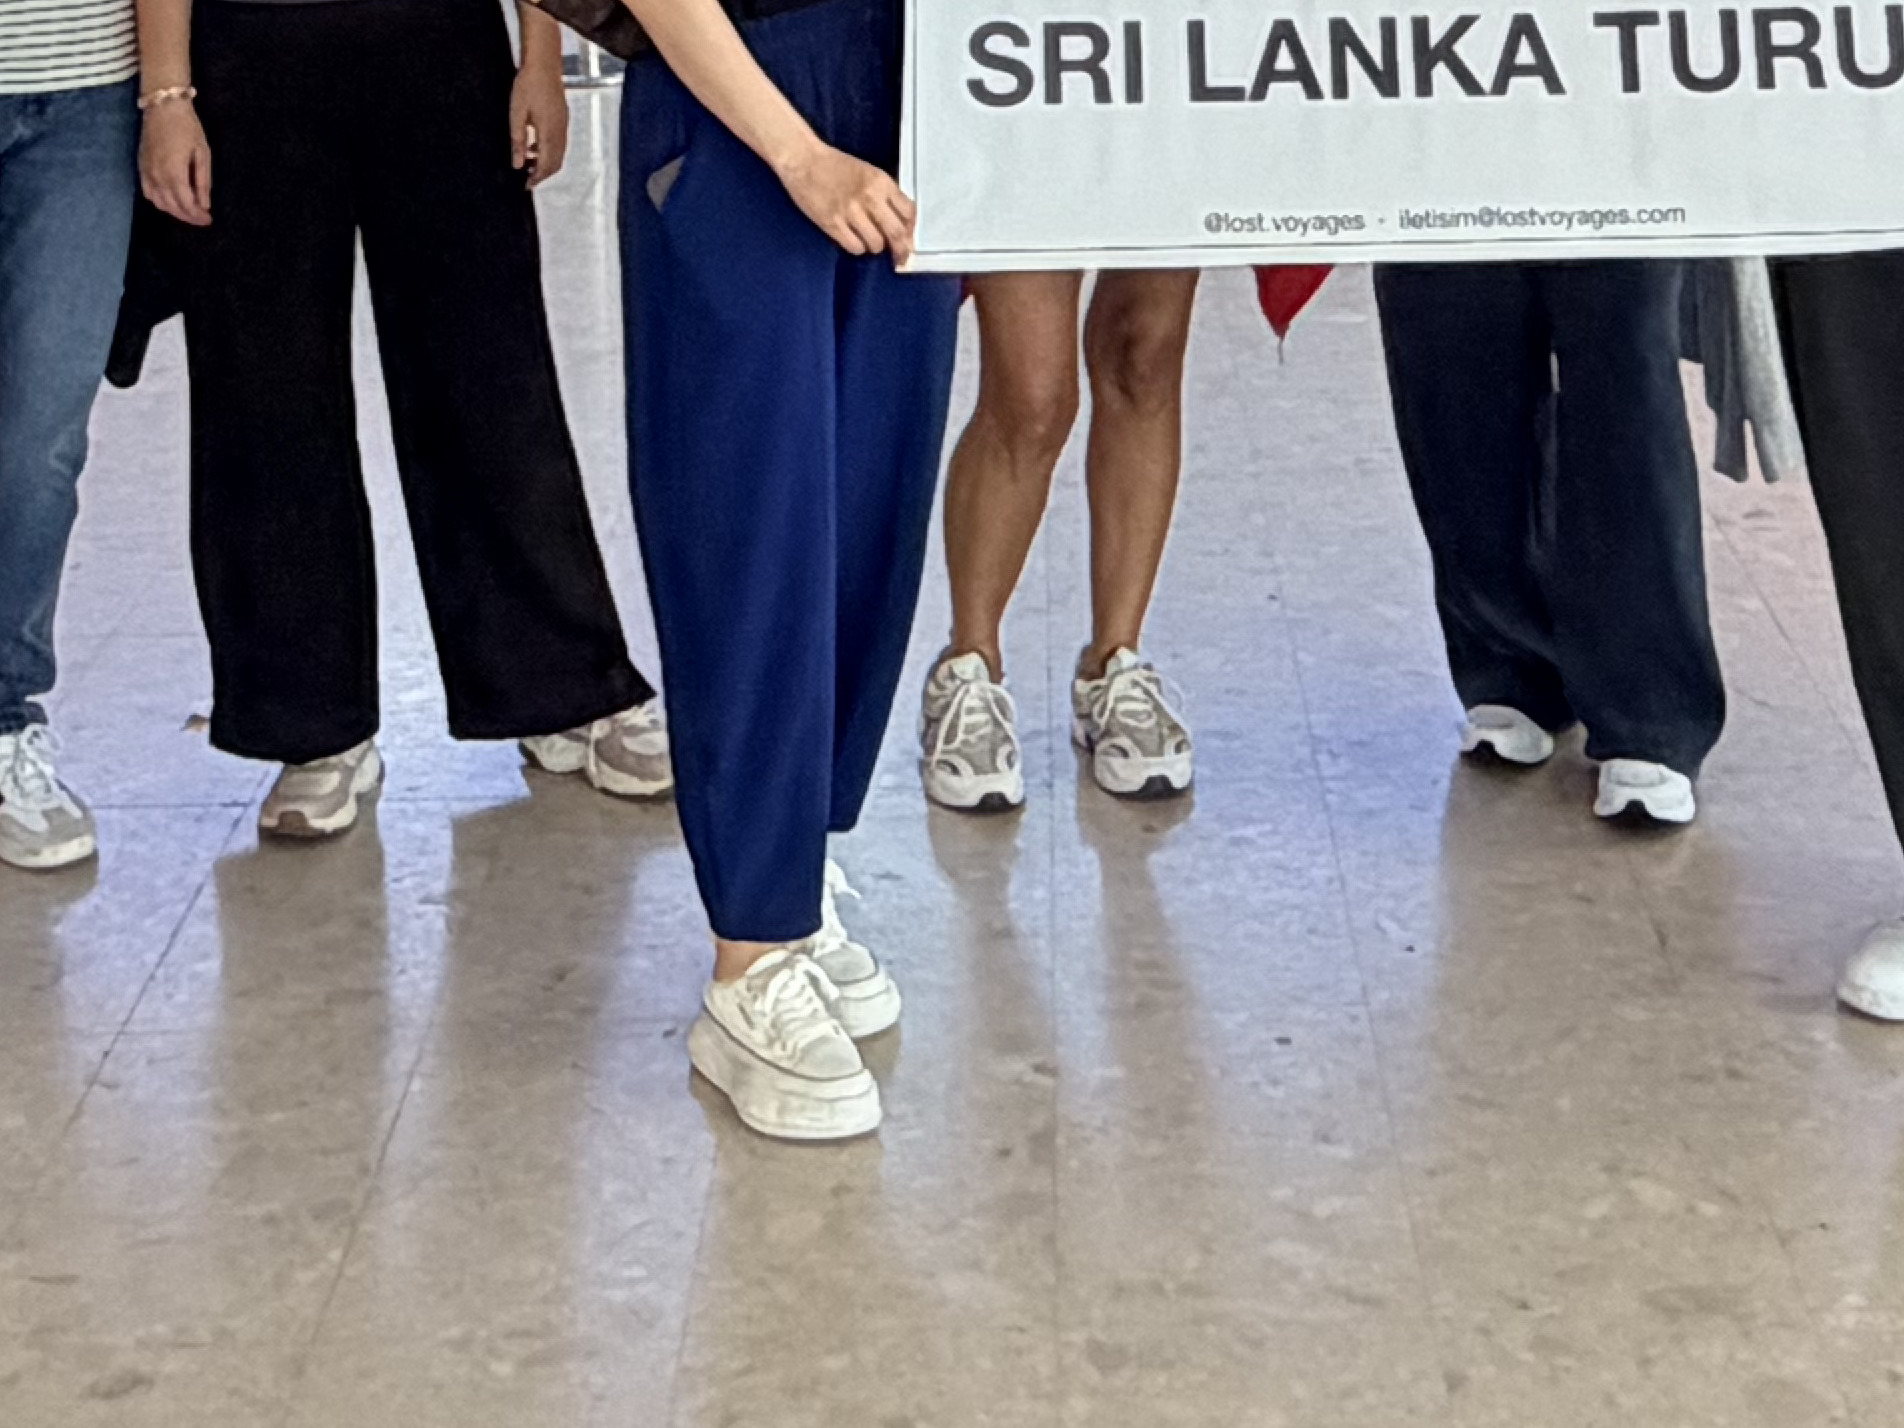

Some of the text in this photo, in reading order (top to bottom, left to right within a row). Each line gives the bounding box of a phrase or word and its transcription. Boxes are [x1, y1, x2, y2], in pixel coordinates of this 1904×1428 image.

[964, 19, 1143, 108] SRI
[1185, 12, 1566, 103] LANKA
[1203, 210, 1367, 238] @lost.voyages
